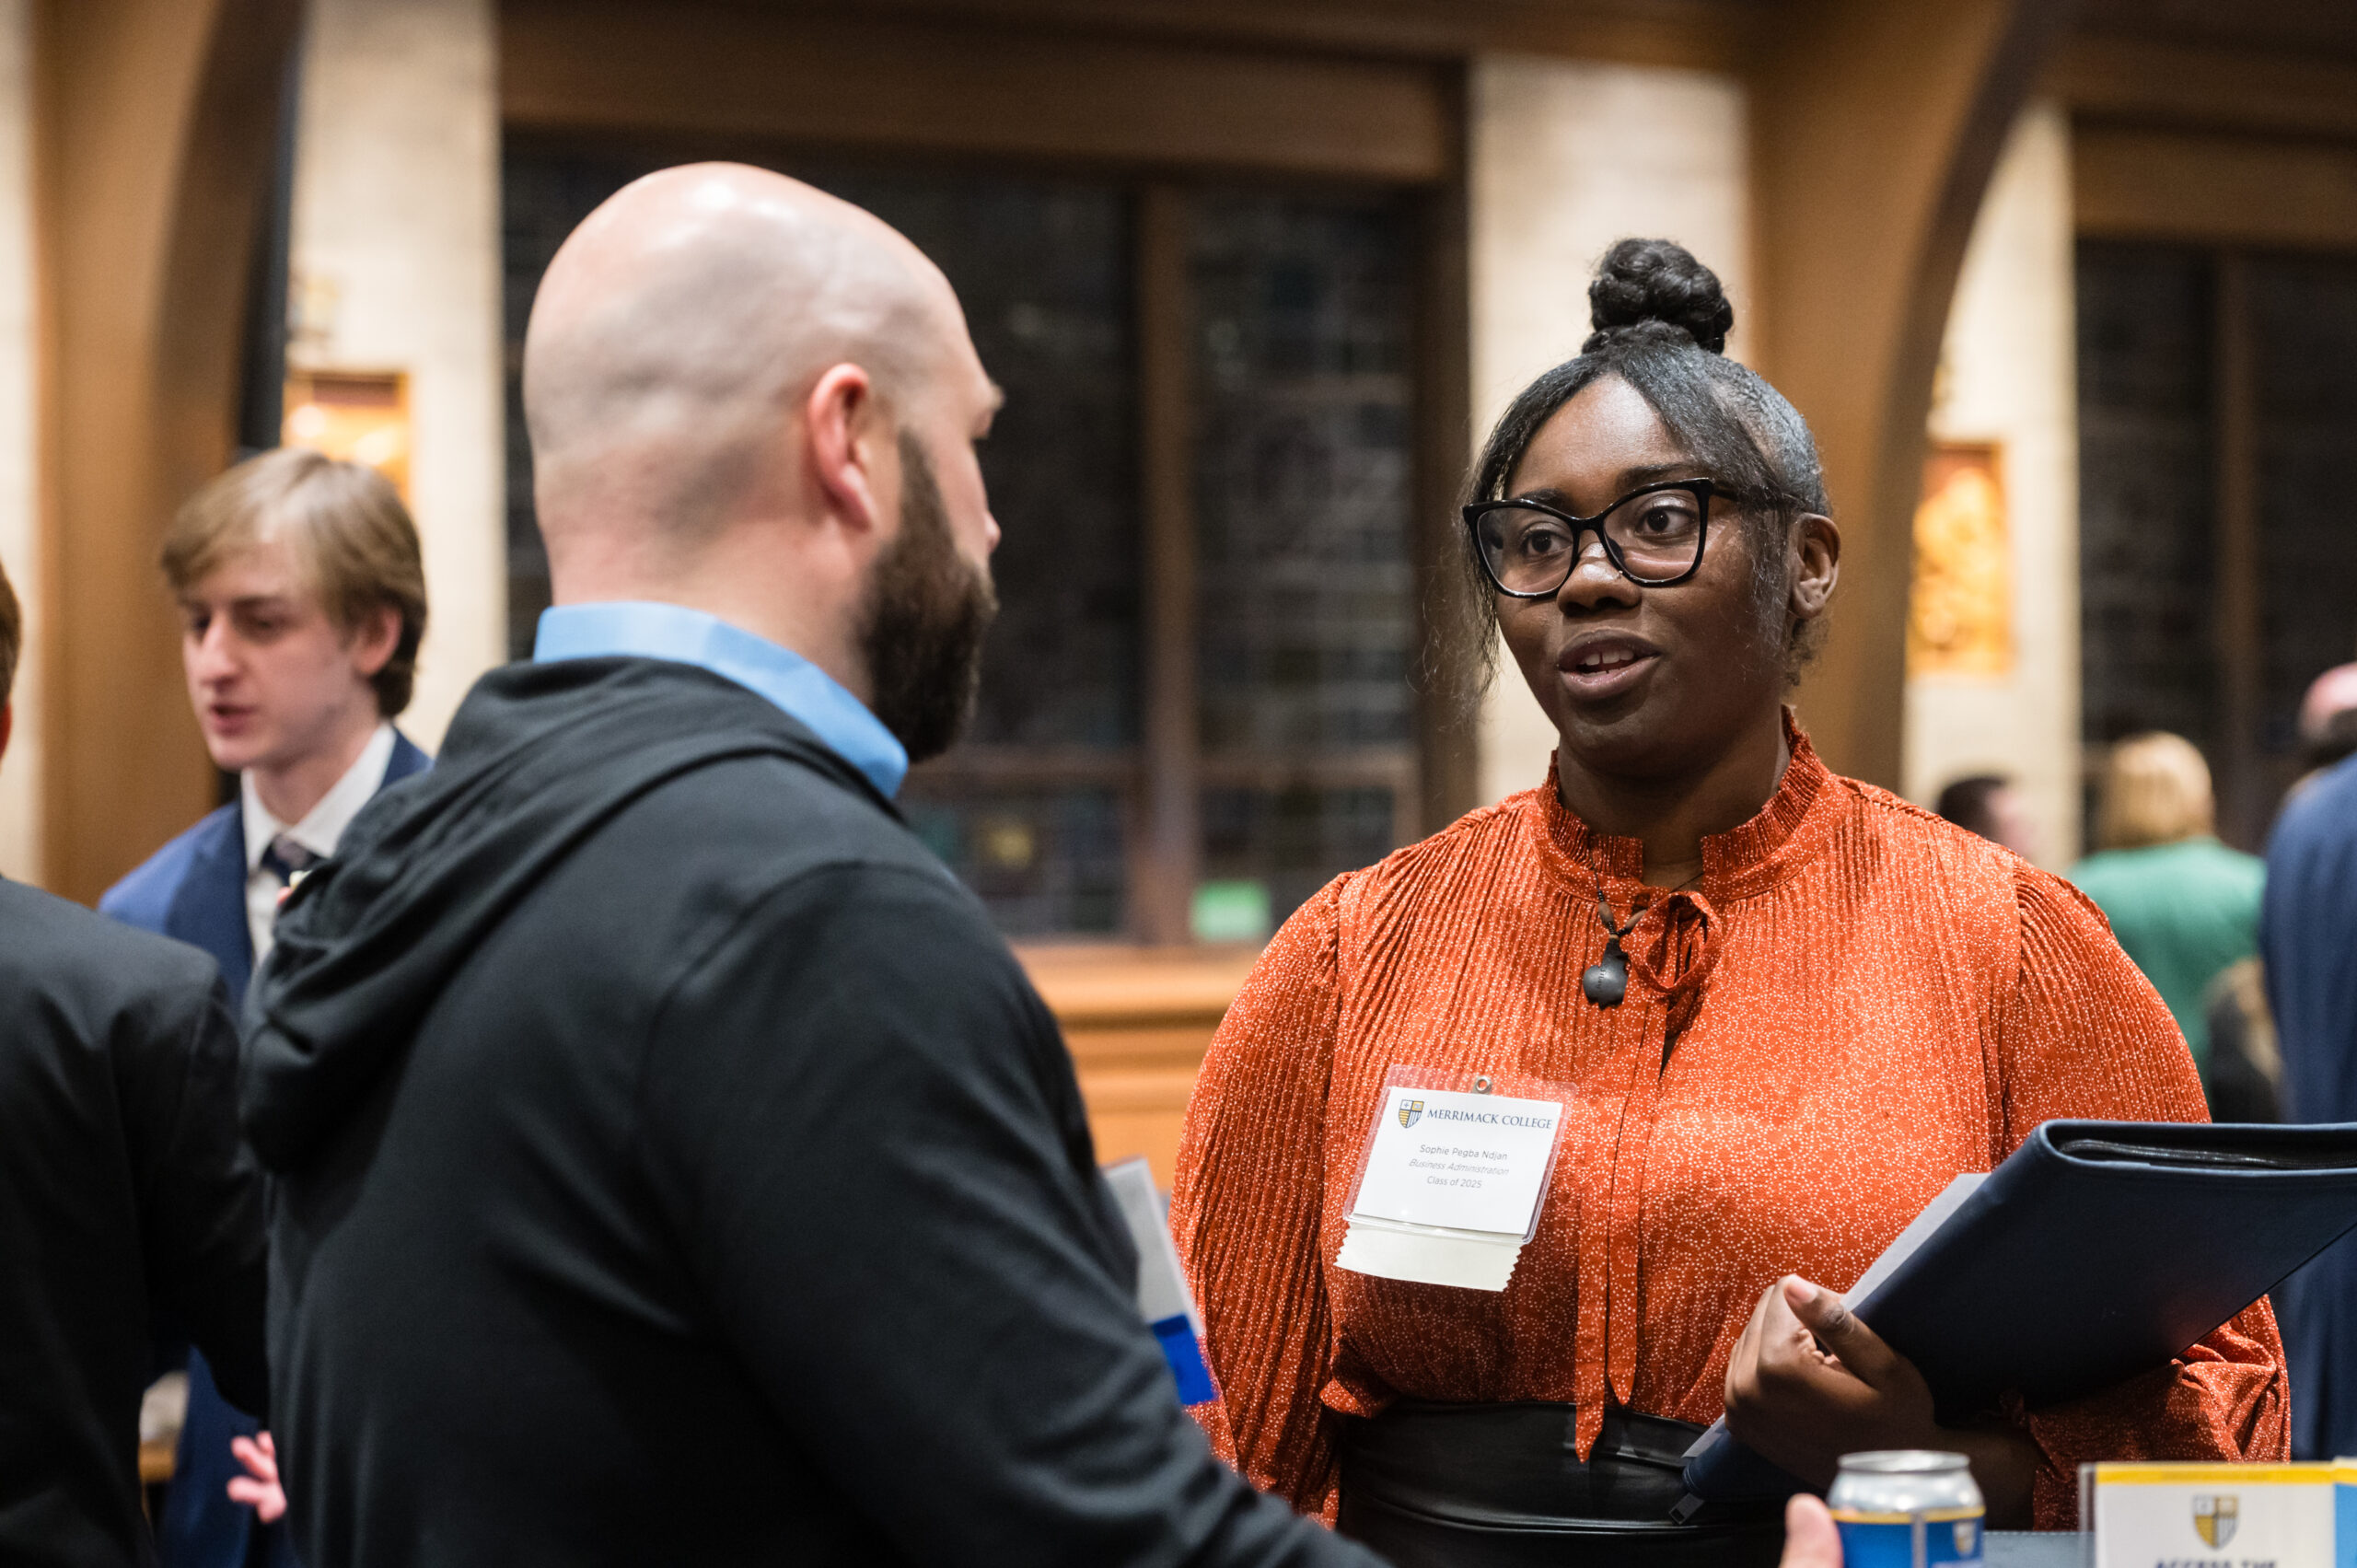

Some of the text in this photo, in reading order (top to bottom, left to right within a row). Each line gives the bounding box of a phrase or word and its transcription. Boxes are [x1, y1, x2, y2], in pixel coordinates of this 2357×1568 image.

[1427, 1109, 1552, 1129] MERRIMACK COLLEGE
[1420, 1144, 1449, 1156] Sophie
[1481, 1150, 1508, 1161] Ndjan
[1409, 1158, 1510, 1176] Business Administration
[1426, 1176, 1482, 1189] Class of 2025
